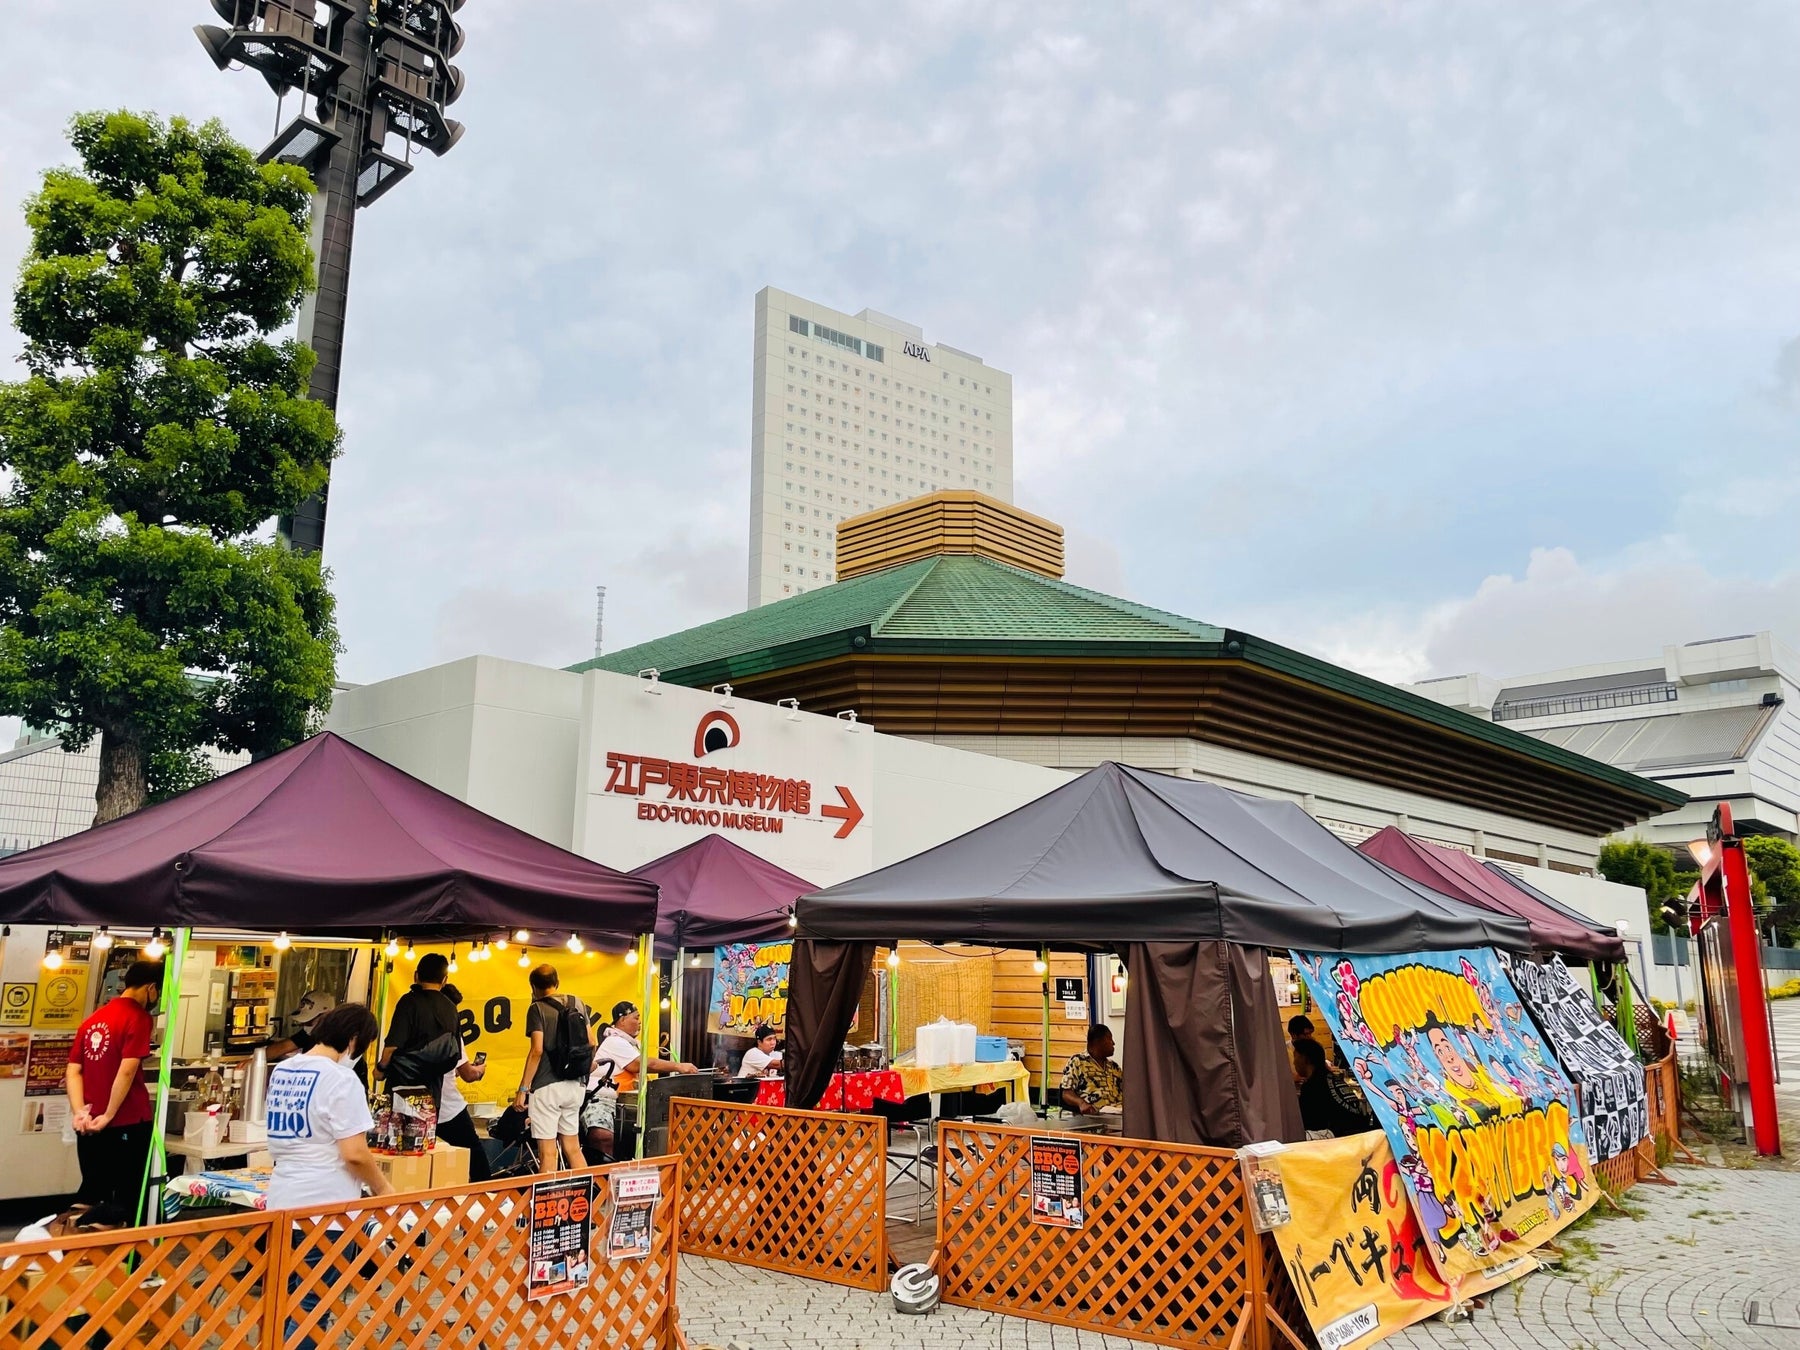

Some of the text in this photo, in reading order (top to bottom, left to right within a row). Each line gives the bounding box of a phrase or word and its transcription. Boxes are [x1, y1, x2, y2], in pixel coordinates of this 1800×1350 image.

[903, 341, 931, 362] APA
[605, 752, 811, 814] 江戸東京博物館
[637, 802, 783, 833] EDO-TOKYO MUSEUM
[458, 996, 512, 1046] BQ
[1033, 1151, 1063, 1171] BBQ
[534, 1198, 570, 1221] BBQ
